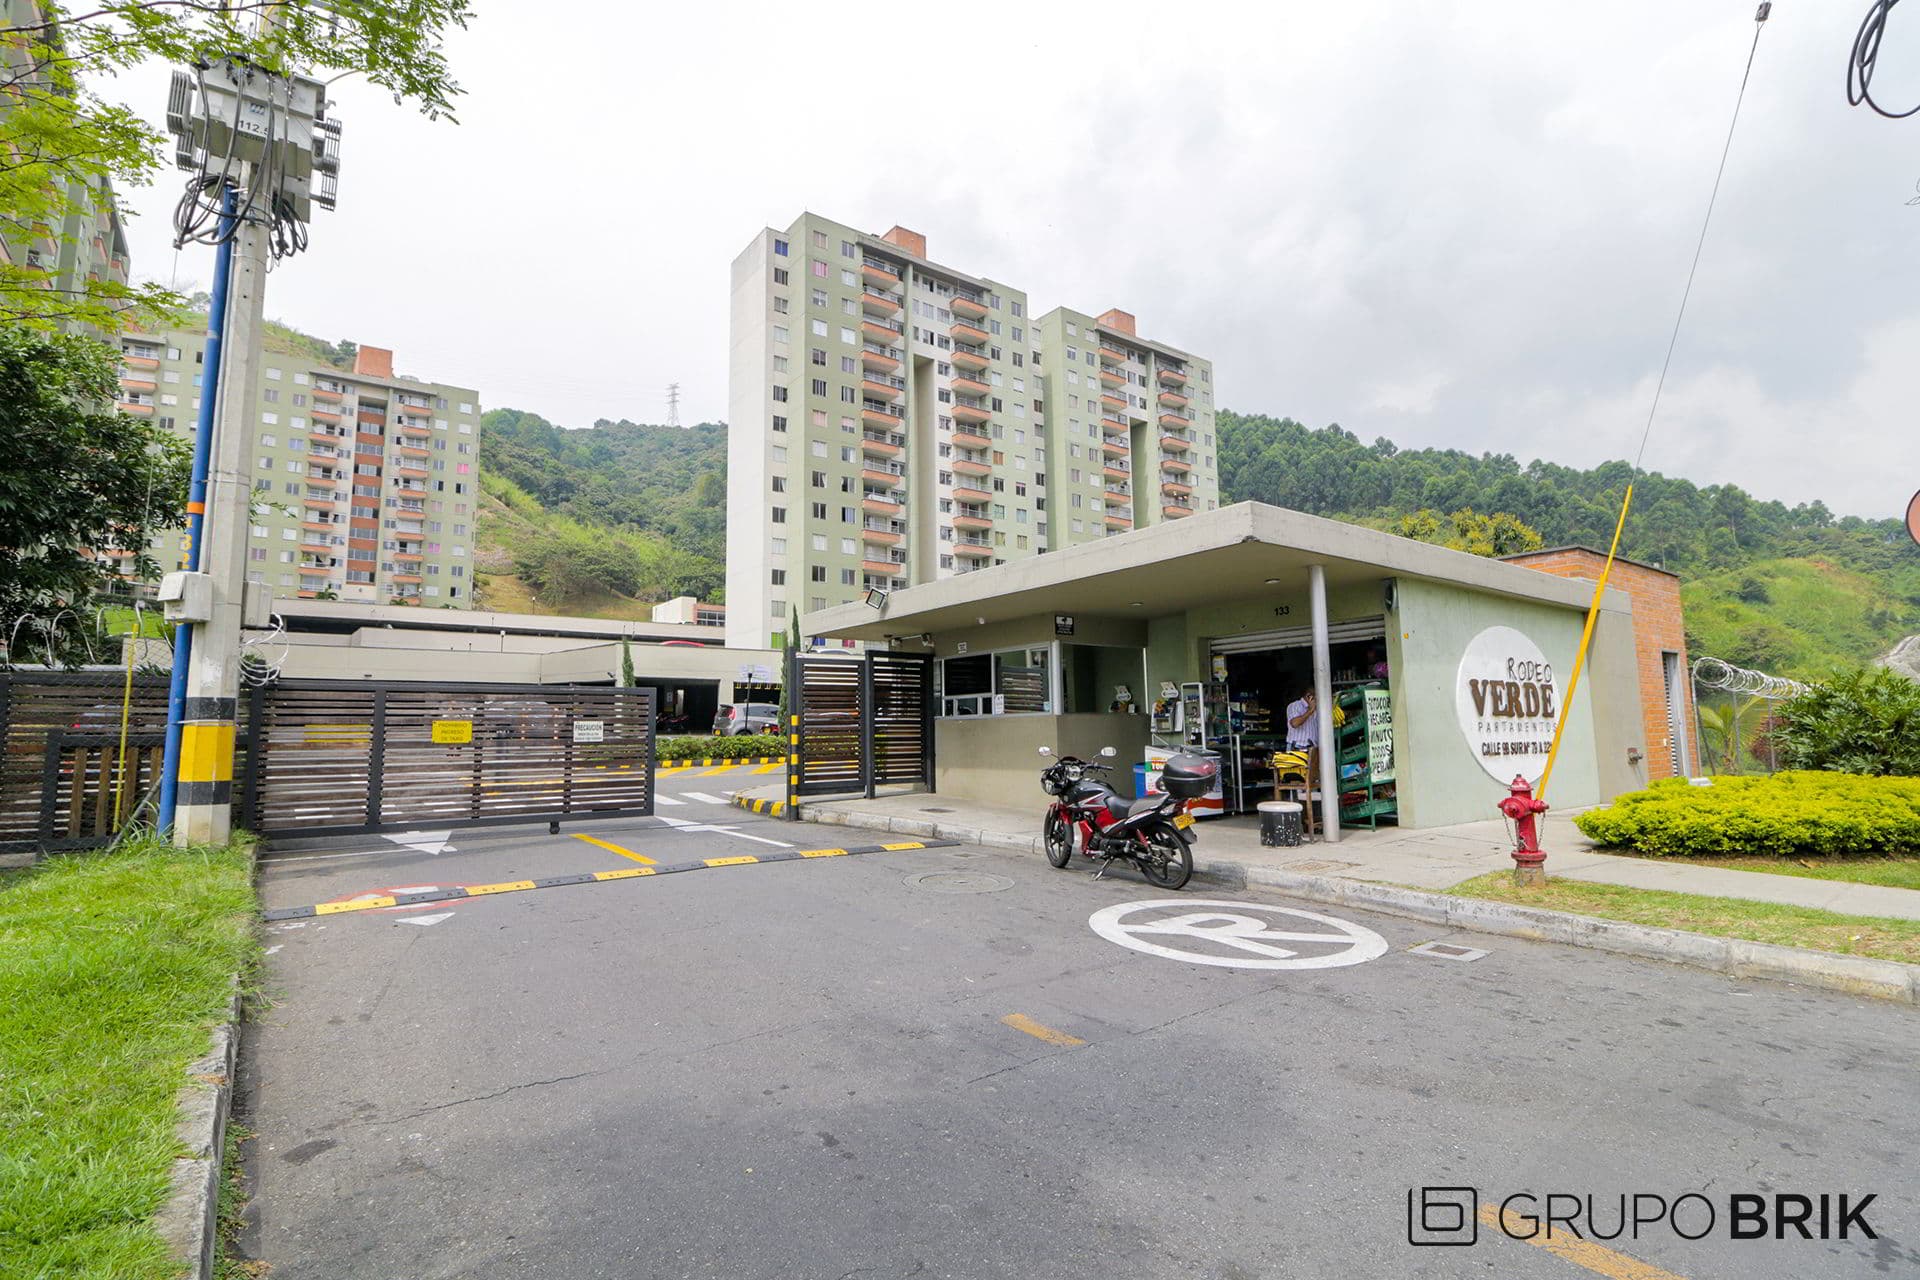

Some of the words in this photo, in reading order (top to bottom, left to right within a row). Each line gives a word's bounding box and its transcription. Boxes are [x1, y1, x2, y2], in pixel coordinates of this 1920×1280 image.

[1274, 605, 1290, 616] 133
[1507, 657, 1552, 683] RODEO
[1469, 678, 1555, 718] VERDE
[1482, 742, 1501, 756] CALLE
